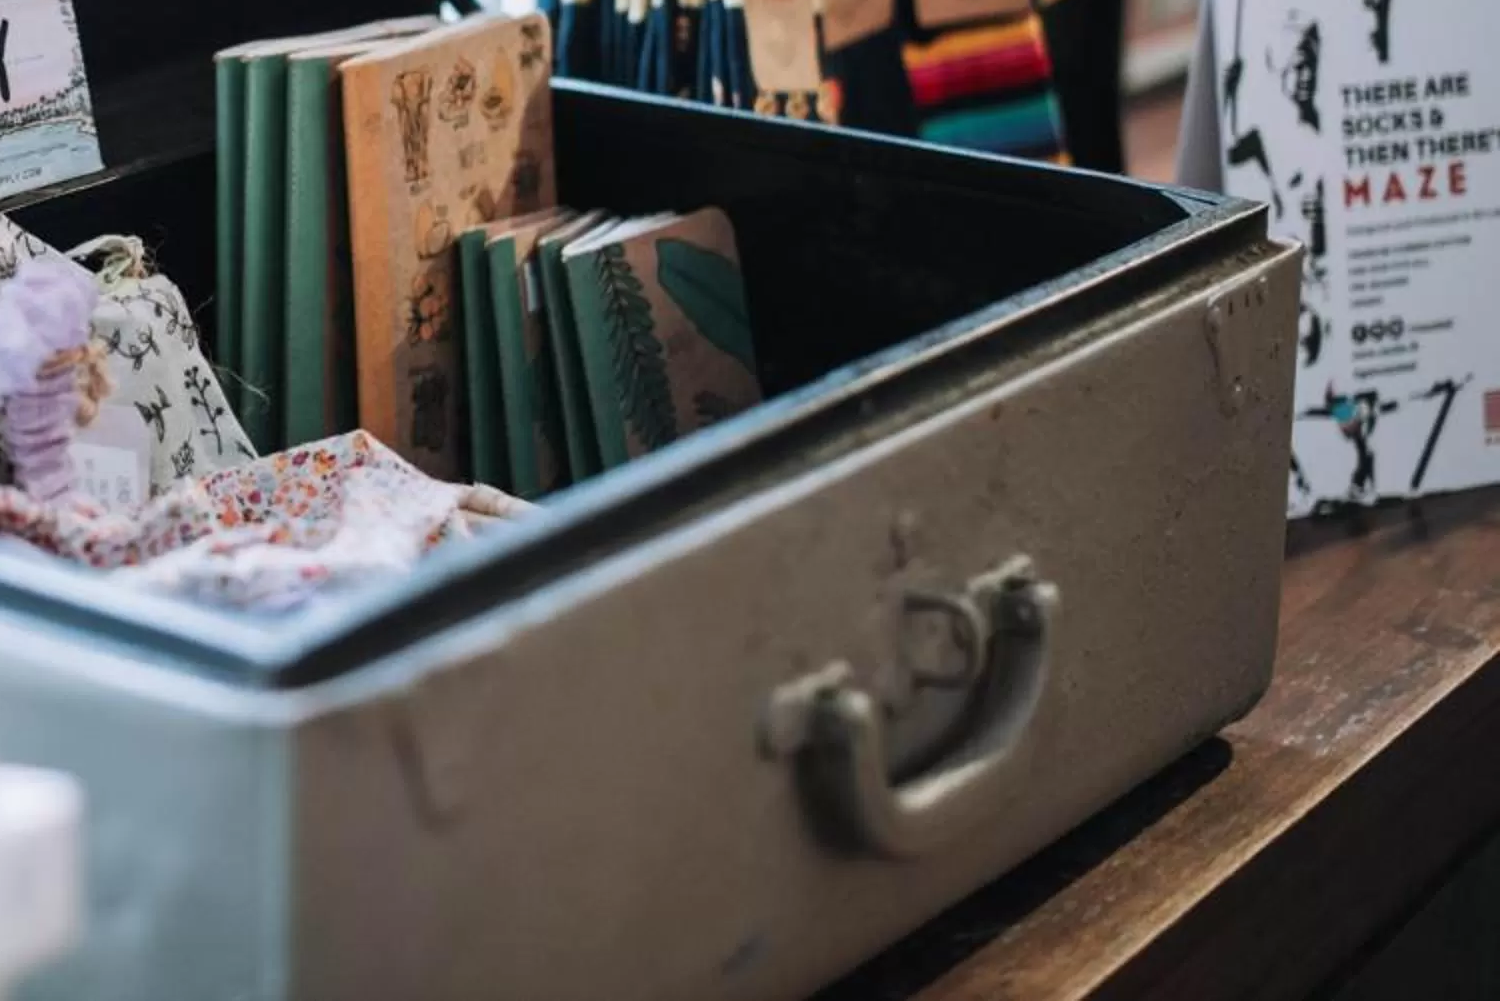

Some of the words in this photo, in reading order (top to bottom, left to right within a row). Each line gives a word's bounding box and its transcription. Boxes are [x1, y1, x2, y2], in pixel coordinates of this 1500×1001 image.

[1340, 80, 1418, 107] THERE
[1424, 72, 1470, 99] ARE
[1342, 109, 1423, 138] SOCKS
[1345, 141, 1410, 168] THEN
[1416, 127, 1500, 159] THERE'
[1342, 159, 1468, 208] MAZE
